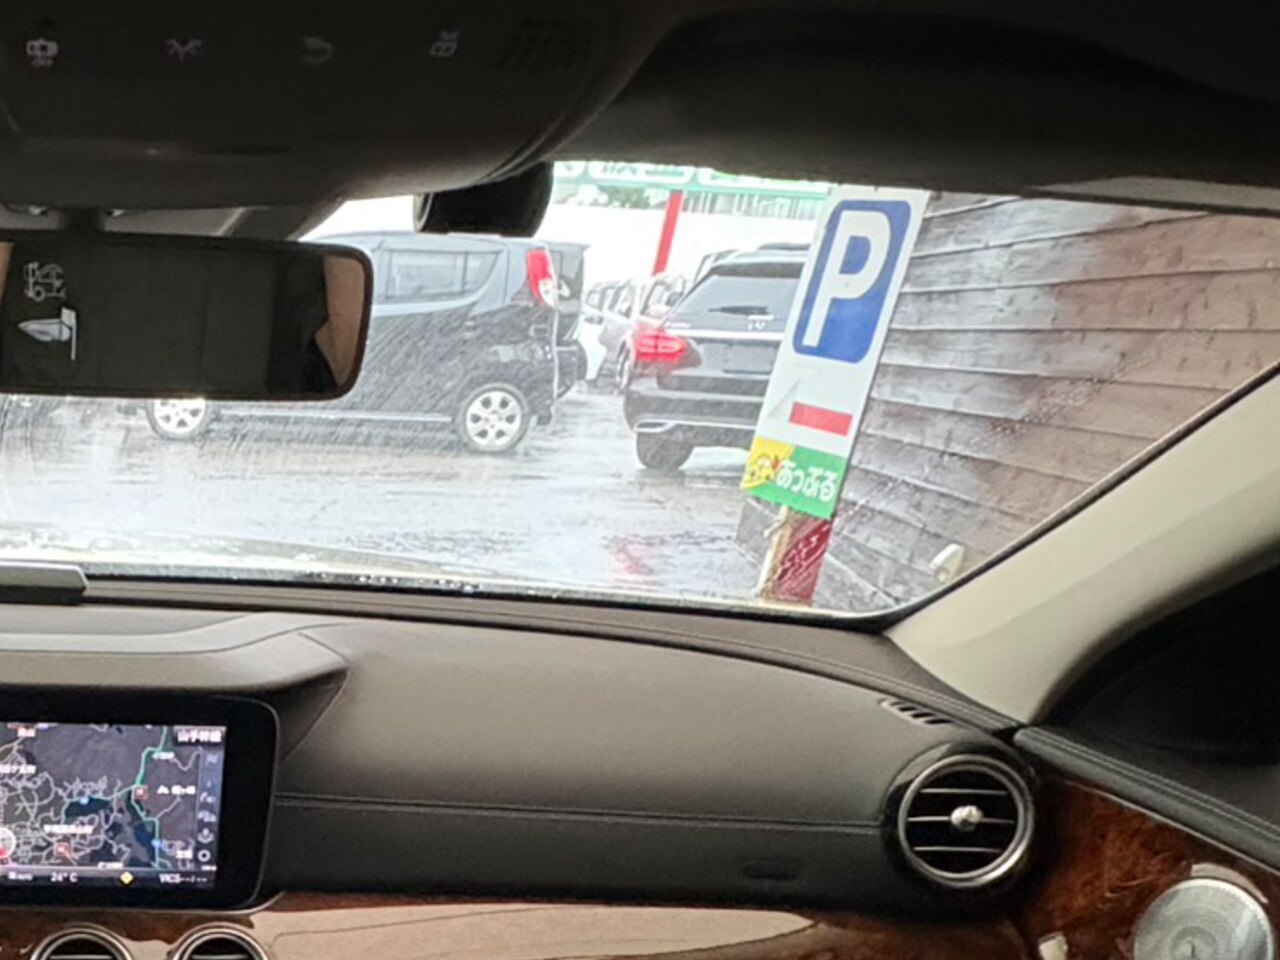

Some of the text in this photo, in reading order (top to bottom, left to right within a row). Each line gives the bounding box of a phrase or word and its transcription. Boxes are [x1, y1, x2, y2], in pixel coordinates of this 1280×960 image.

[802, 210, 891, 347] P
[776, 459, 838, 502] あっぷる
